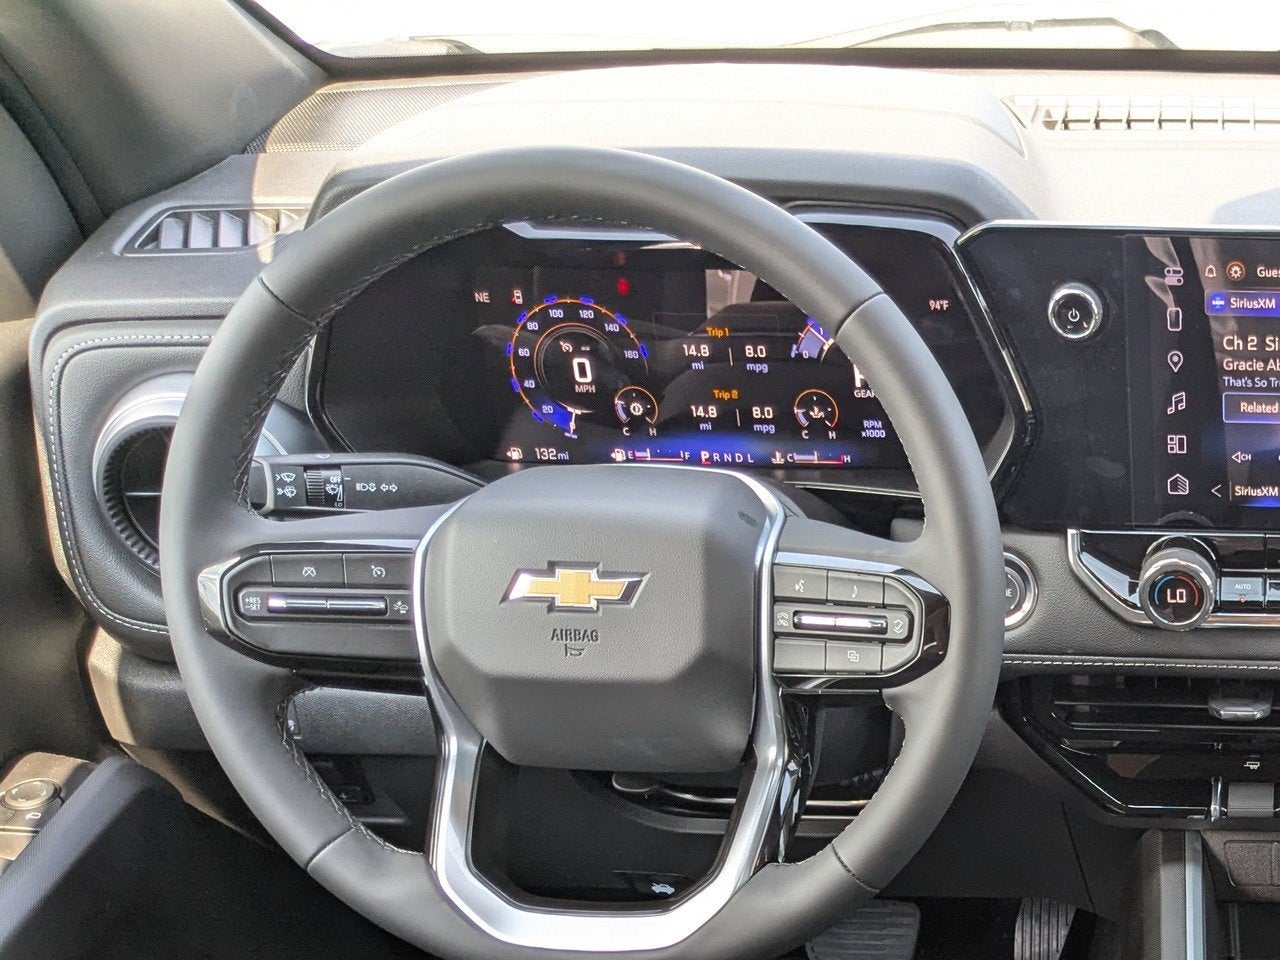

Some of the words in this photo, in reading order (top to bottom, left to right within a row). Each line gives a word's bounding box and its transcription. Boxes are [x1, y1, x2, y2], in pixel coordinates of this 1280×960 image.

[474, 292, 490, 303] NE
[1230, 297, 1276, 309] SiriusXM
[549, 309, 564, 318] 100
[579, 310, 594, 319] 120
[527, 322, 538, 331] 80
[604, 323, 619, 332] 140
[706, 327, 724, 339] Trip
[1223, 336, 1243, 351] Ch
[1248, 337, 1257, 351] 2
[518, 348, 530, 357] 60
[624, 350, 639, 359] 160
[683, 344, 710, 358] 14.8
[745, 345, 767, 358] 8.0
[802, 351, 809, 359] 0
[692, 362, 705, 370] mi
[746, 363, 769, 374] mpg
[1223, 358, 1264, 372] Gracie
[572, 357, 593, 383] 0
[523, 380, 535, 389] 40
[1223, 376, 1252, 388] That's
[1255, 377, 1268, 388] So
[574, 384, 596, 394] MPH
[713, 389, 730, 401] Trip
[731, 390, 739, 399] 2
[542, 405, 554, 414] 20
[691, 405, 717, 419] 14.8
[752, 406, 773, 419] 8.0
[1240, 401, 1279, 414] Related
[700, 422, 712, 431] mi
[753, 424, 776, 434] mpg
[863, 420, 883, 429] RPM
[622, 427, 631, 436] C
[649, 428, 657, 437] H
[801, 429, 809, 439] C
[829, 431, 836, 440] H
[861, 429, 886, 438] x1000
[628, 451, 633, 459] E
[685, 452, 691, 460] F
[701, 451, 709, 462] P
[713, 453, 720, 462] R
[724, 453, 732, 462] N
[735, 454, 743, 462] D
[748, 454, 754, 463] L
[787, 453, 794, 462] C
[844, 455, 851, 463] H
[1241, 453, 1252, 461] CH
[330, 476, 342, 484] OFF
[1234, 486, 1279, 497] SiriusXM
[1167, 589, 1186, 604] LO
[550, 628, 599, 643] AIRBAG
